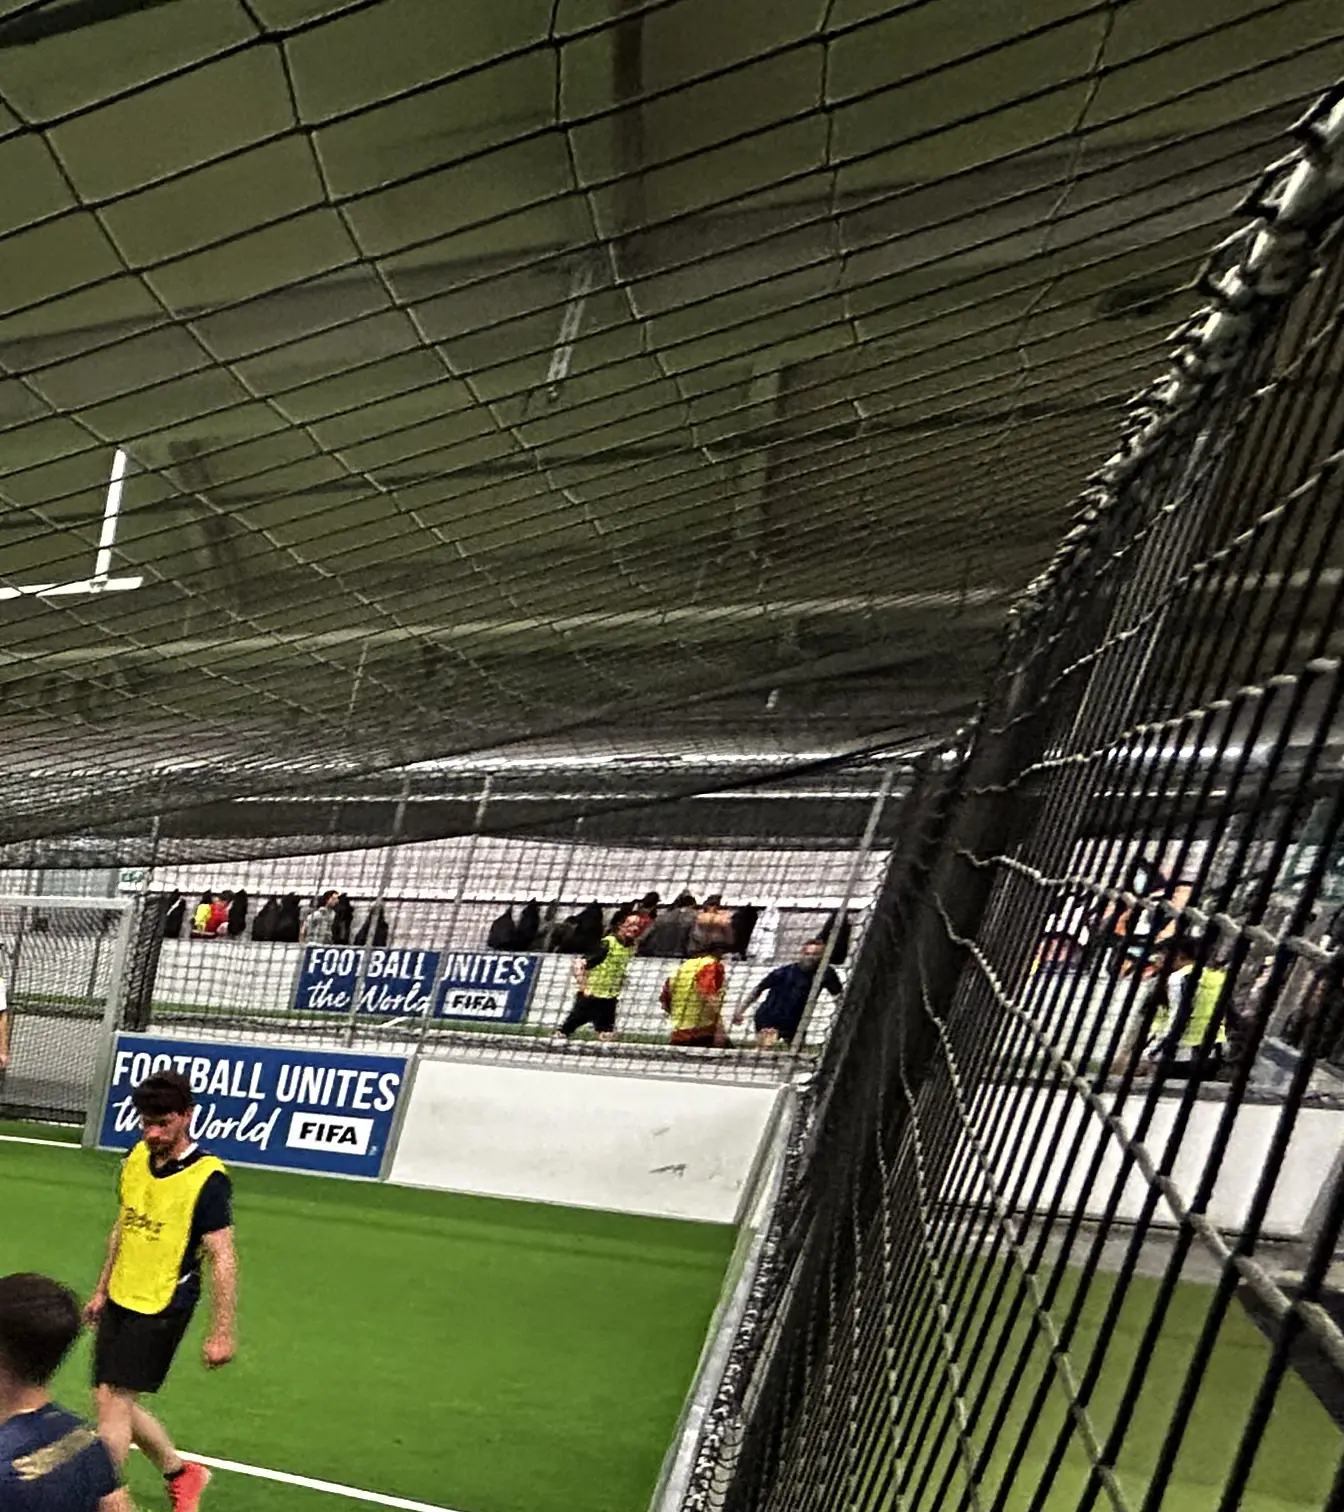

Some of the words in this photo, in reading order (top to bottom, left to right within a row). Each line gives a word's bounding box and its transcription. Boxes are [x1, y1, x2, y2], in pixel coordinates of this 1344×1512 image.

[308, 948, 425, 980] FOOTBALL
[307, 979, 349, 1008] the
[452, 994, 497, 1010] FIFA
[276, 1063, 400, 1112] UNITES
[299, 1122, 358, 1145] FIFA
